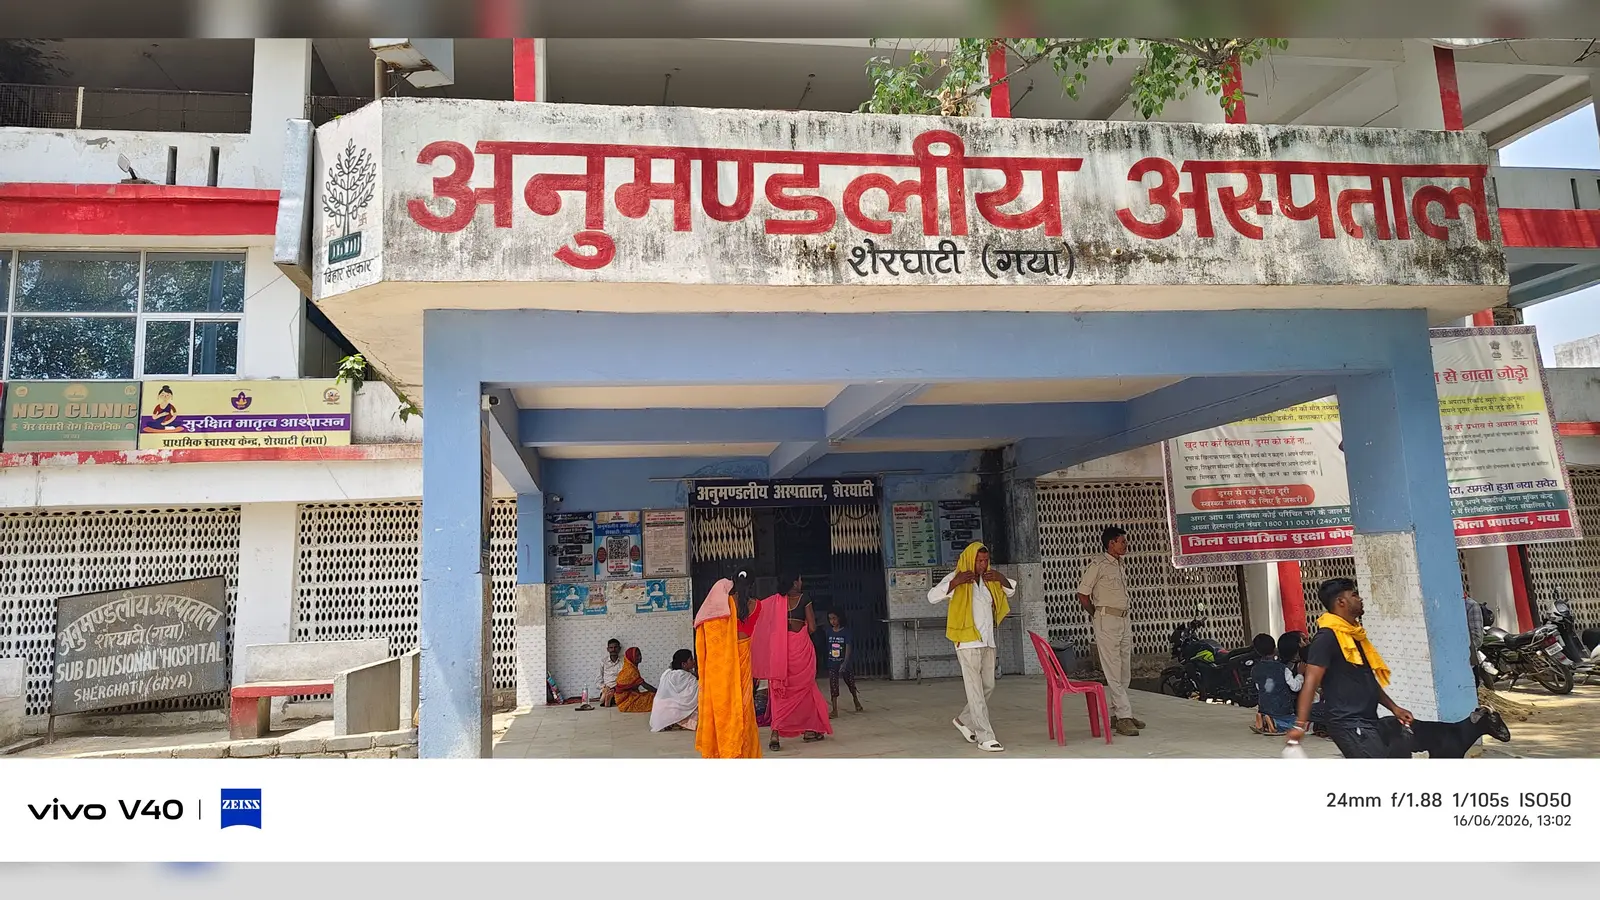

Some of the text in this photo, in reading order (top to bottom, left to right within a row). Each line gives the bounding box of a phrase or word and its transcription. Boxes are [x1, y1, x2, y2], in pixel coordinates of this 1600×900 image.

[407, 131, 1492, 269] अनुमण्डलीय अस्पताल
[848, 238, 1075, 279] शेरघाटी (गया)
[324, 258, 374, 285] बिहार सरकार
[1443, 368, 1458, 384] से
[1460, 368, 1494, 382] नाता
[1496, 364, 1529, 384] जोड़ो
[12, 403, 138, 419] NCD CLINIC
[183, 416, 345, 432] सुरक्षित मातृत्व आश्वासन
[696, 480, 874, 505] अनुमण्डलीय अस्पताल, शेरघाटी
[1467, 478, 1558, 495] समझो हुआ नया सवेरा
[1236, 512, 1260, 520] आपका
[1262, 511, 1277, 520] कोई
[1278, 509, 1302, 518] परिचित
[1304, 508, 1316, 516] नशे
[1316, 517, 1340, 526] (24x7)
[1454, 514, 1560, 530] जिला प्रशासन, गया
[1188, 536, 1224, 548] जिला
[1228, 532, 1288, 545] सामाजिक
[1292, 530, 1326, 544] सुरक्षा
[58, 590, 223, 656] अनुमण्डलीय अस्पताल
[55, 641, 224, 683] SUB DIVISIONAL HOSPITAL
[74, 671, 193, 703] SHERGHATI (GAYA)
